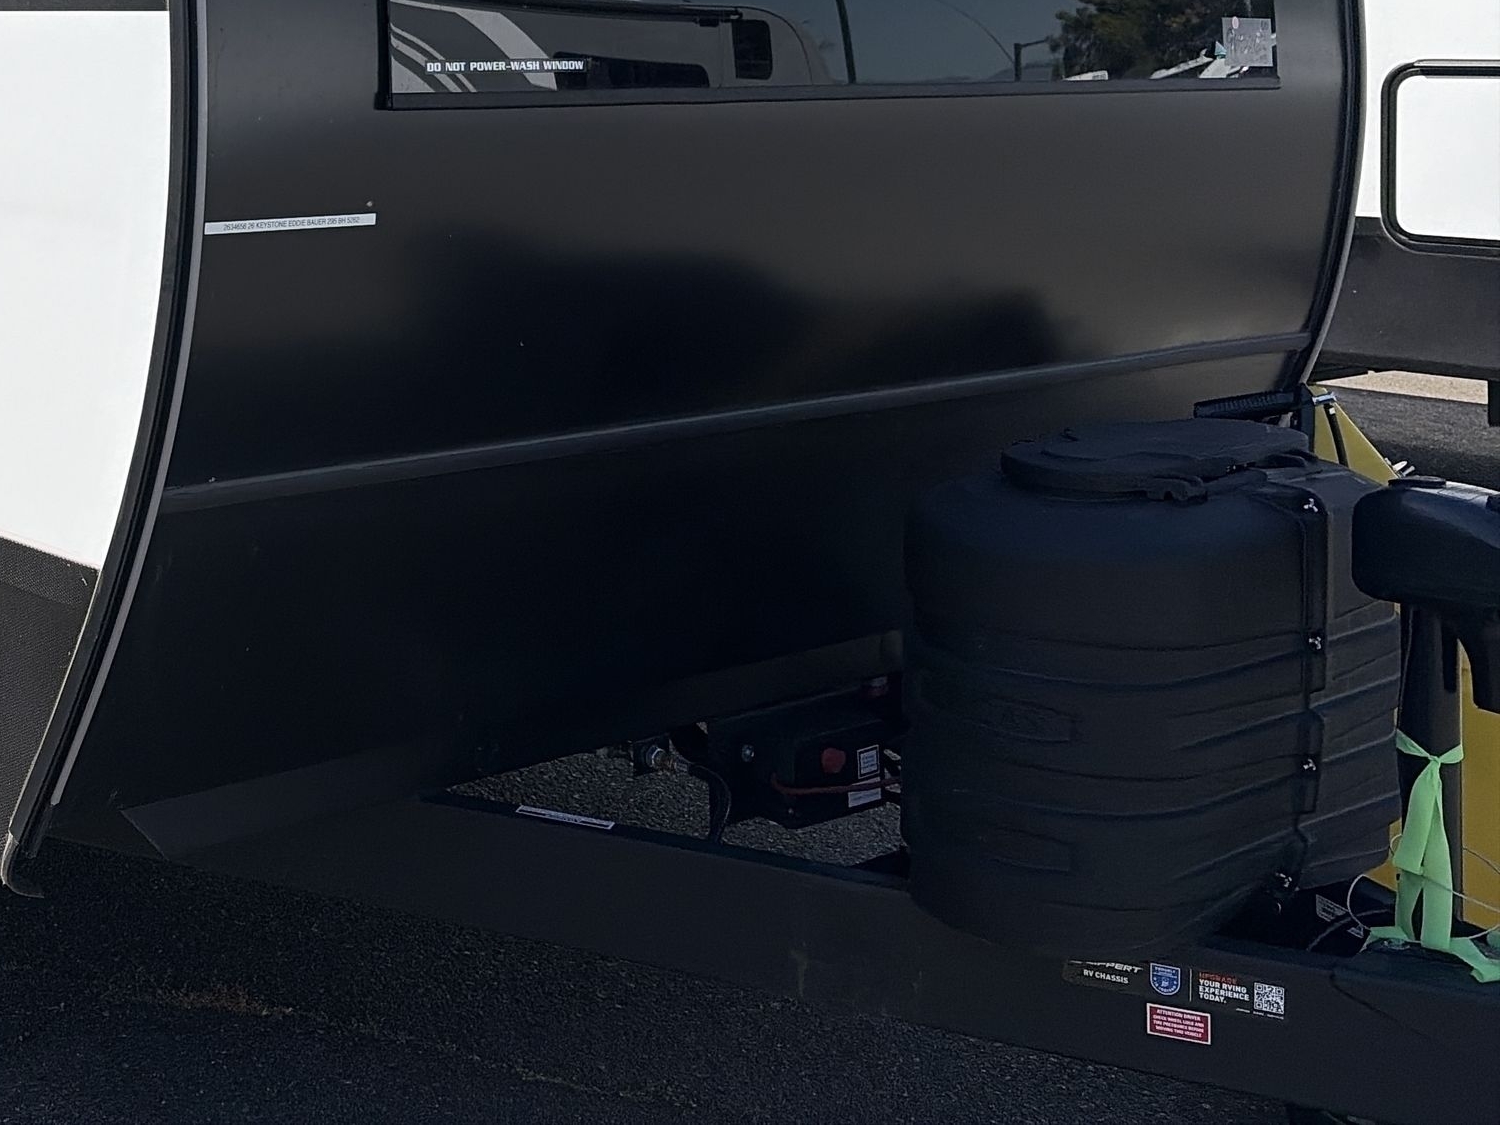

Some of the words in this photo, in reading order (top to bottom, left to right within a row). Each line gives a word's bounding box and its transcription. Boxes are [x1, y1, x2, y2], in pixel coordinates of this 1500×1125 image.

[426, 62, 442, 72] DO
[445, 62, 466, 72] NOT
[470, 61, 540, 72] POWER-WASH
[543, 60, 584, 70] WINDOW
[256, 220, 288, 229] KEYSTONE
[288, 218, 306, 227] EDDIE
[307, 217, 326, 226] BAUER
[1083, 969, 1094, 977] RV
[1095, 971, 1129, 984] CHASSIS
[1199, 979, 1220, 988] YOUR
[1222, 983, 1248, 994] RVING
[1199, 985, 1250, 1001] EXPERIENCE
[1199, 992, 1227, 1004] TODAY.
